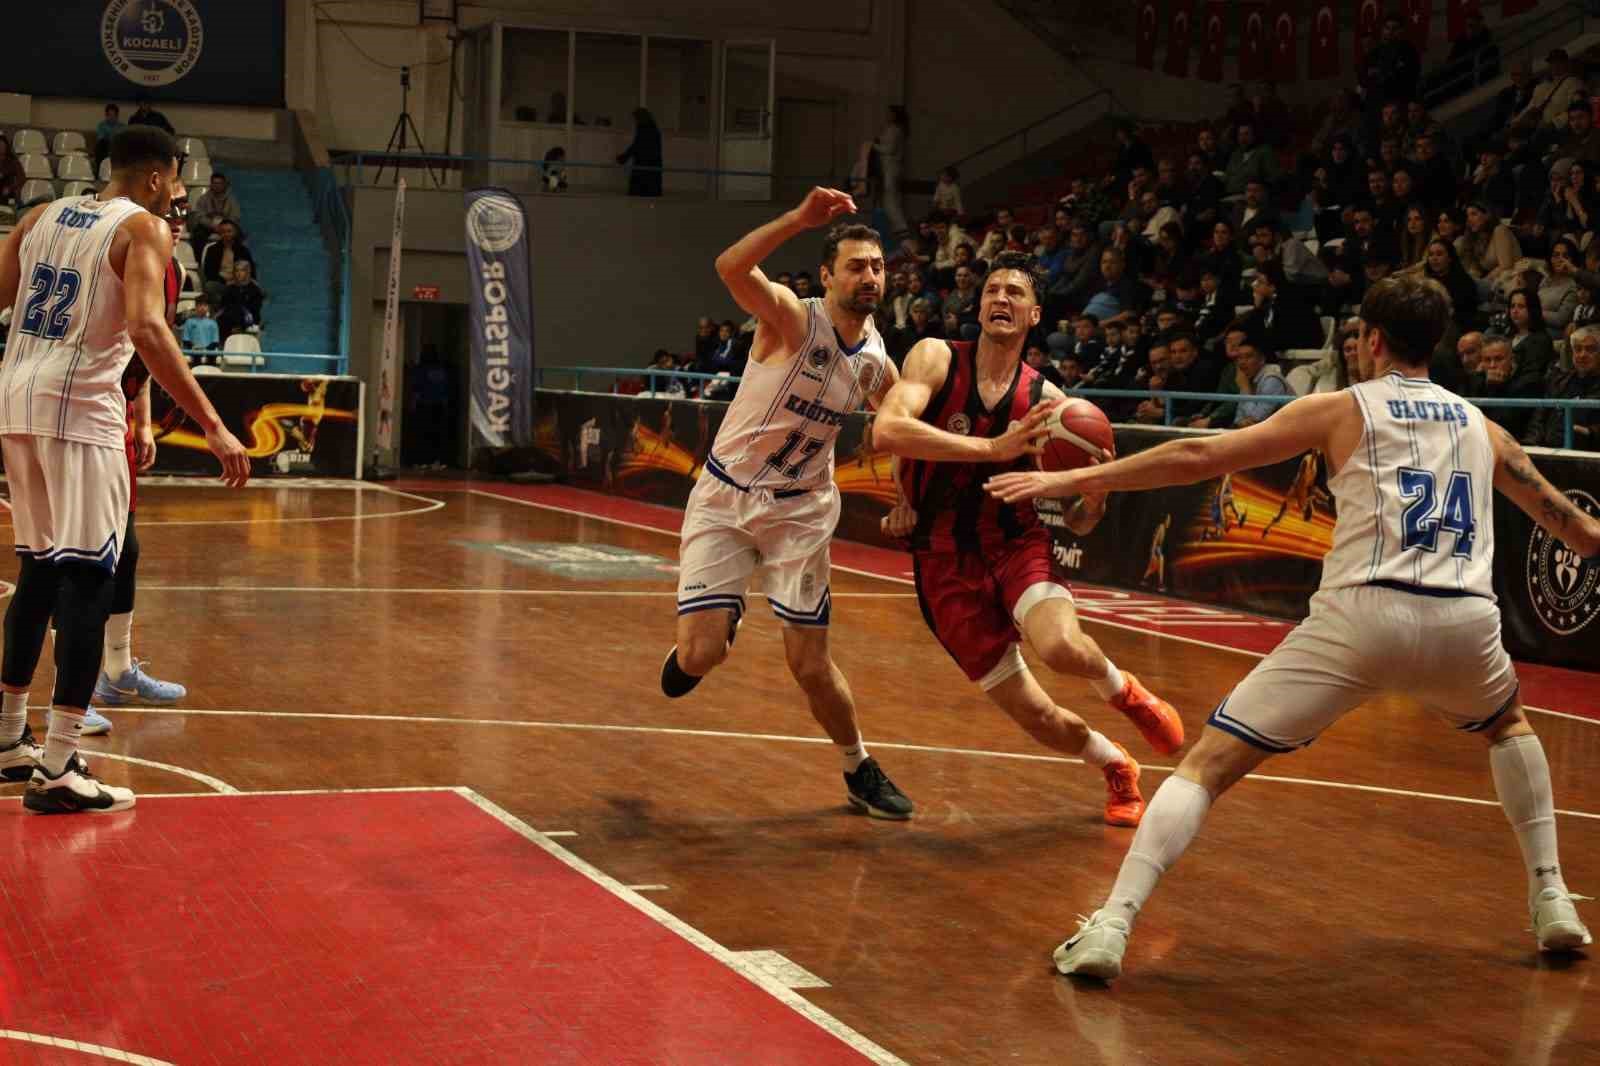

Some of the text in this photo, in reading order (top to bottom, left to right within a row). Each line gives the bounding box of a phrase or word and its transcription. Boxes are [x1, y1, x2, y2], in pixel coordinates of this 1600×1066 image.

[17, 262, 82, 340] 22
[1386, 400, 1468, 427] ULUTAŞ
[766, 430, 825, 479] 17
[1396, 466, 1478, 561] 24
